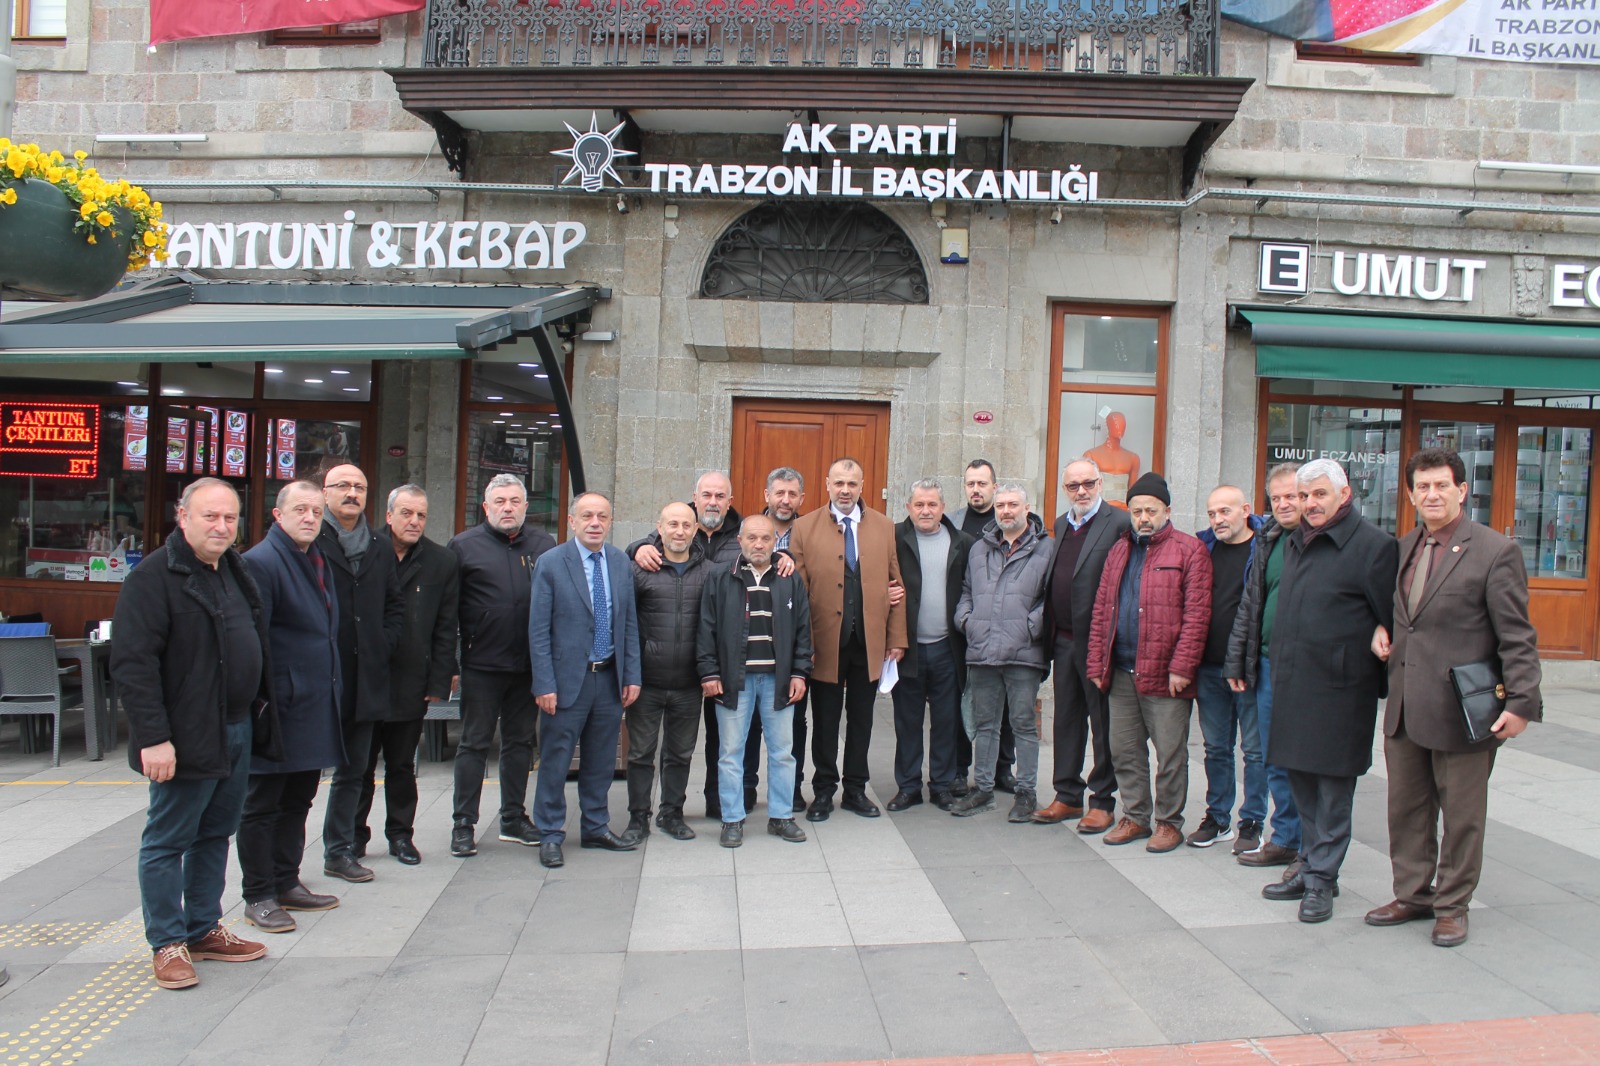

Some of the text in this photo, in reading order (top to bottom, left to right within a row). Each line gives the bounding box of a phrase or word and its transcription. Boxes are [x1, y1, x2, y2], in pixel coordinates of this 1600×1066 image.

[1500, 0, 1531, 11] AK
[1468, 34, 1486, 54] İL
[782, 118, 957, 155] AK PARTİ
[644, 159, 1099, 203] TRABZON İL BAŞKANLIĞI
[366, 220, 402, 269] &
[414, 220, 587, 270] KEBAP
[1332, 251, 1487, 302] UMUT
[12, 410, 86, 427] TANTUNi
[1274, 447, 1315, 461] UMUT
